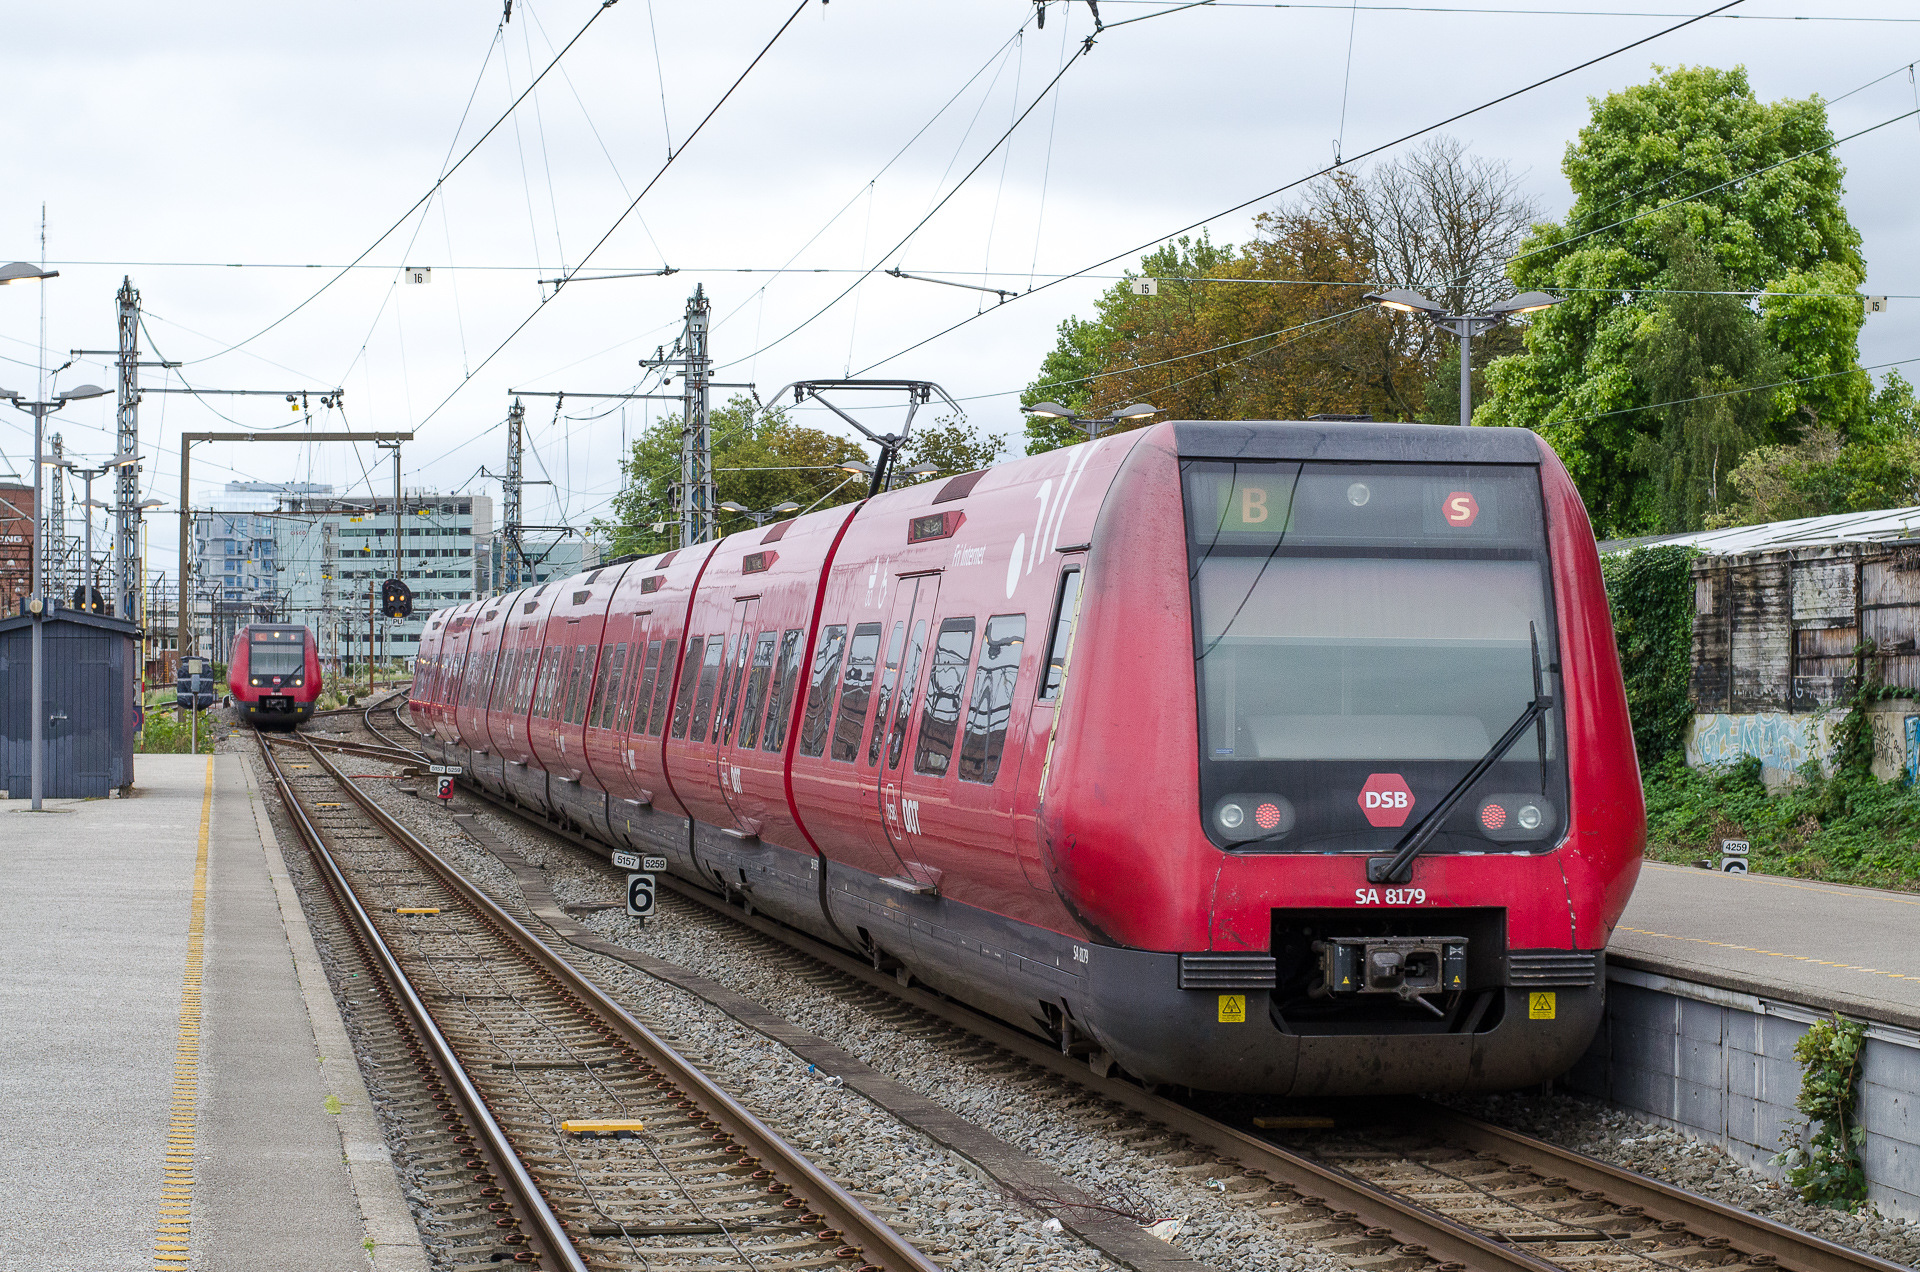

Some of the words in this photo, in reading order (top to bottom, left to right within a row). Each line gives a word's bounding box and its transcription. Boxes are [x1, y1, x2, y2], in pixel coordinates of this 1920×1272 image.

[414, 273, 423, 284] 16
[1141, 284, 1150, 294] 15
[1872, 301, 1880, 312] 15
[1241, 488, 1269, 523] B
[1450, 497, 1471, 521] S
[439, 779, 452, 796] 8
[1365, 791, 1409, 809] DSB
[902, 798, 921, 836] DOT
[1725, 843, 1748, 852] 4259
[617, 855, 636, 867] 5157
[645, 859, 665, 869] 5259
[629, 877, 653, 913] 6
[1355, 888, 1380, 905] SA
[1385, 888, 1426, 905] 8179
